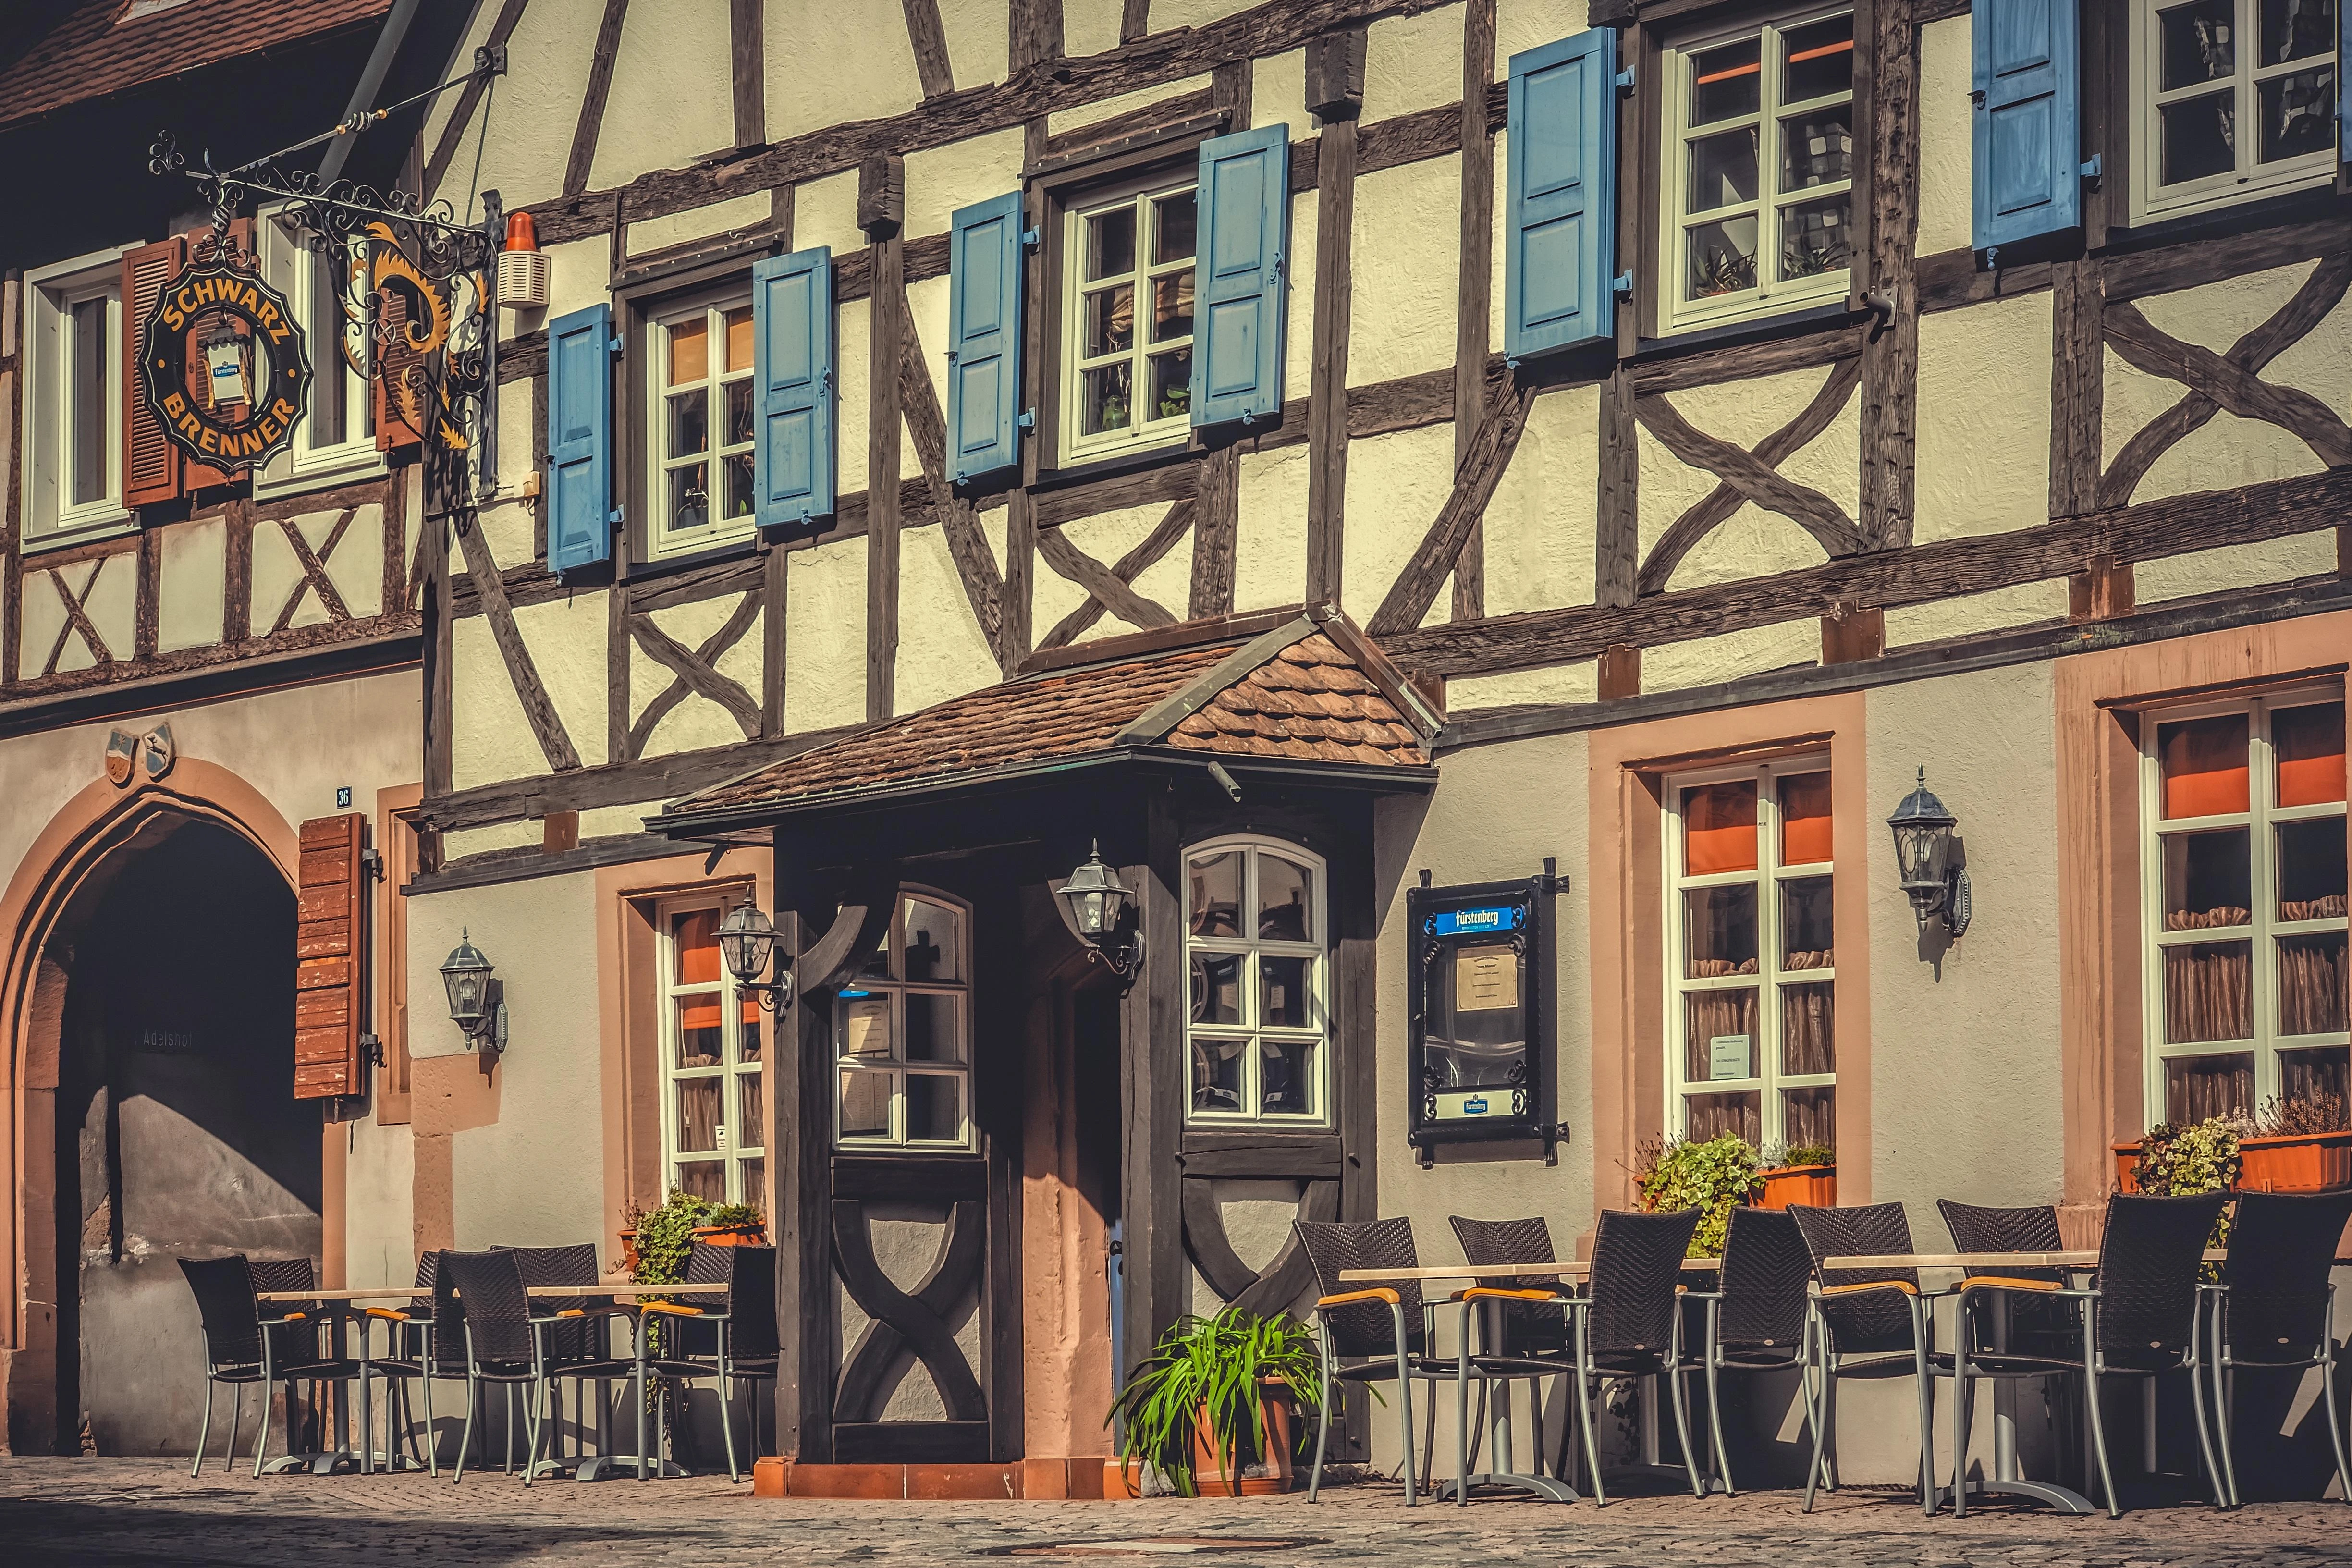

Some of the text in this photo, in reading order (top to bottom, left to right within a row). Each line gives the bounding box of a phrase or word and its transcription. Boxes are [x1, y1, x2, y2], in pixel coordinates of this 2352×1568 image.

[163, 278, 290, 345] SCHWARZ
[163, 391, 295, 458] BRENNER
[339, 789, 349, 805] 36
[143, 1028, 192, 1047] Adelshof
